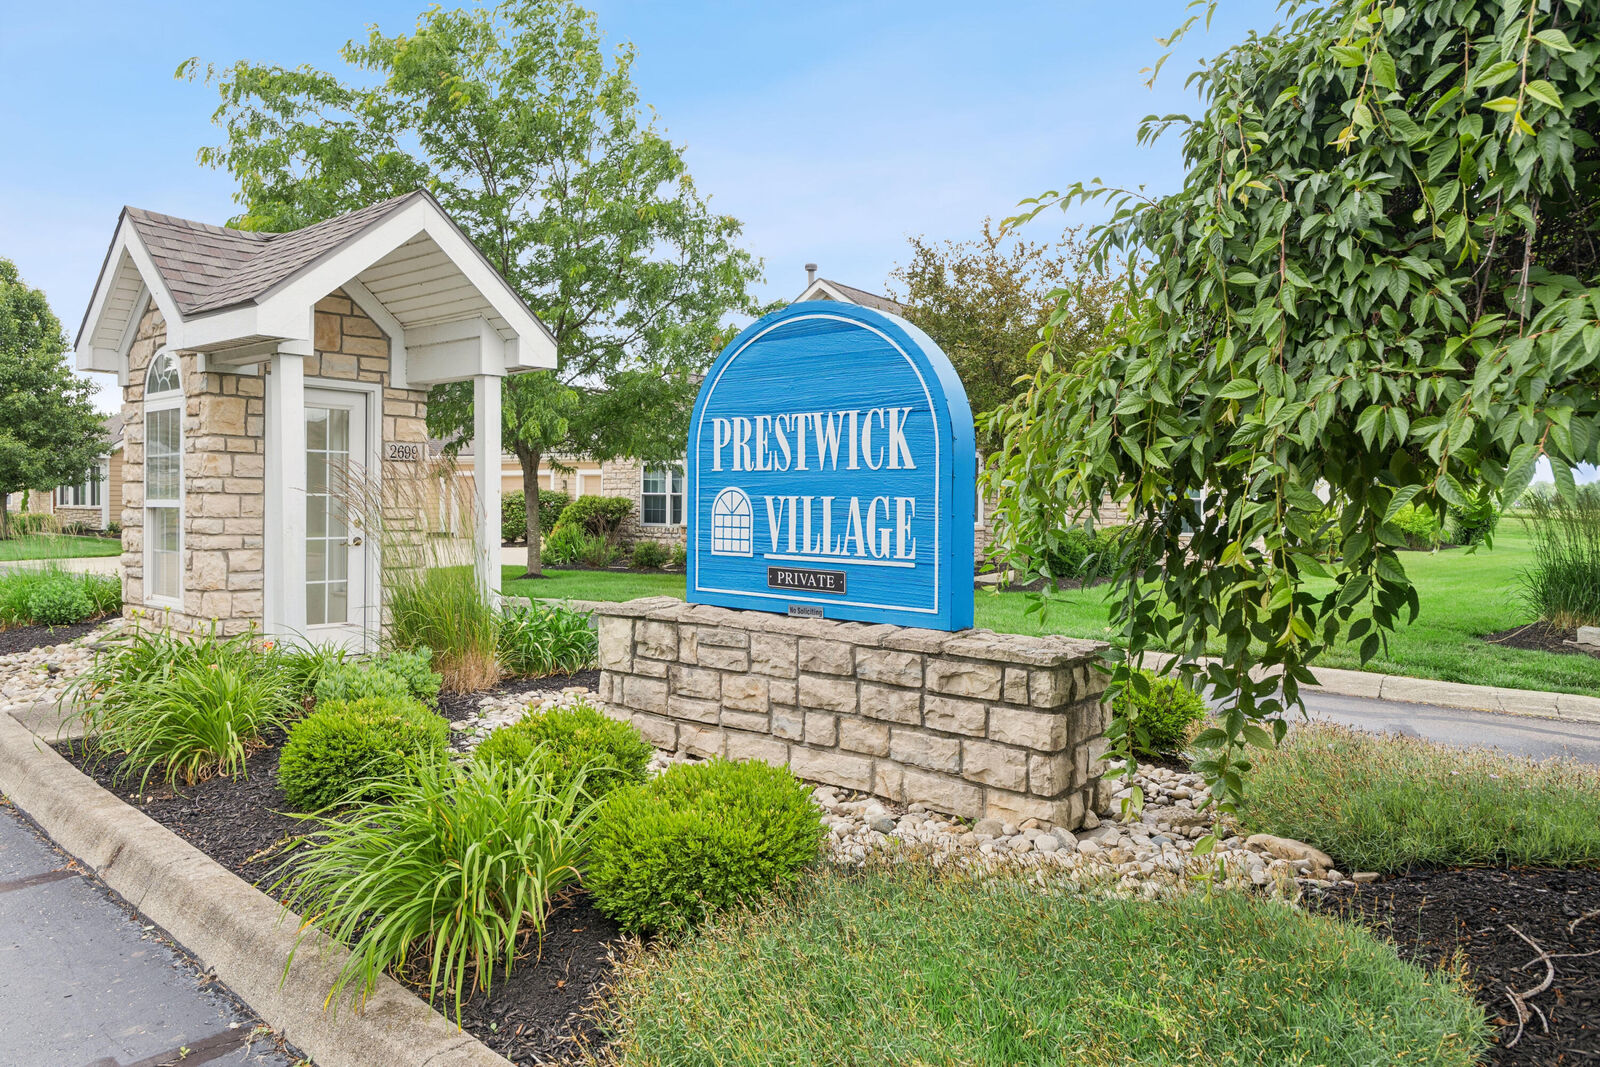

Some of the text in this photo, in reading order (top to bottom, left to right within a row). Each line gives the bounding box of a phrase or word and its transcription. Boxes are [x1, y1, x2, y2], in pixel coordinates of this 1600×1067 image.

[711, 406, 917, 472] PRESTWICK
[390, 444, 418, 460] 2699
[763, 496, 916, 560] VILLAGE
[777, 571, 835, 588] PRIVATE
[789, 606, 822, 618] No Soliciting
